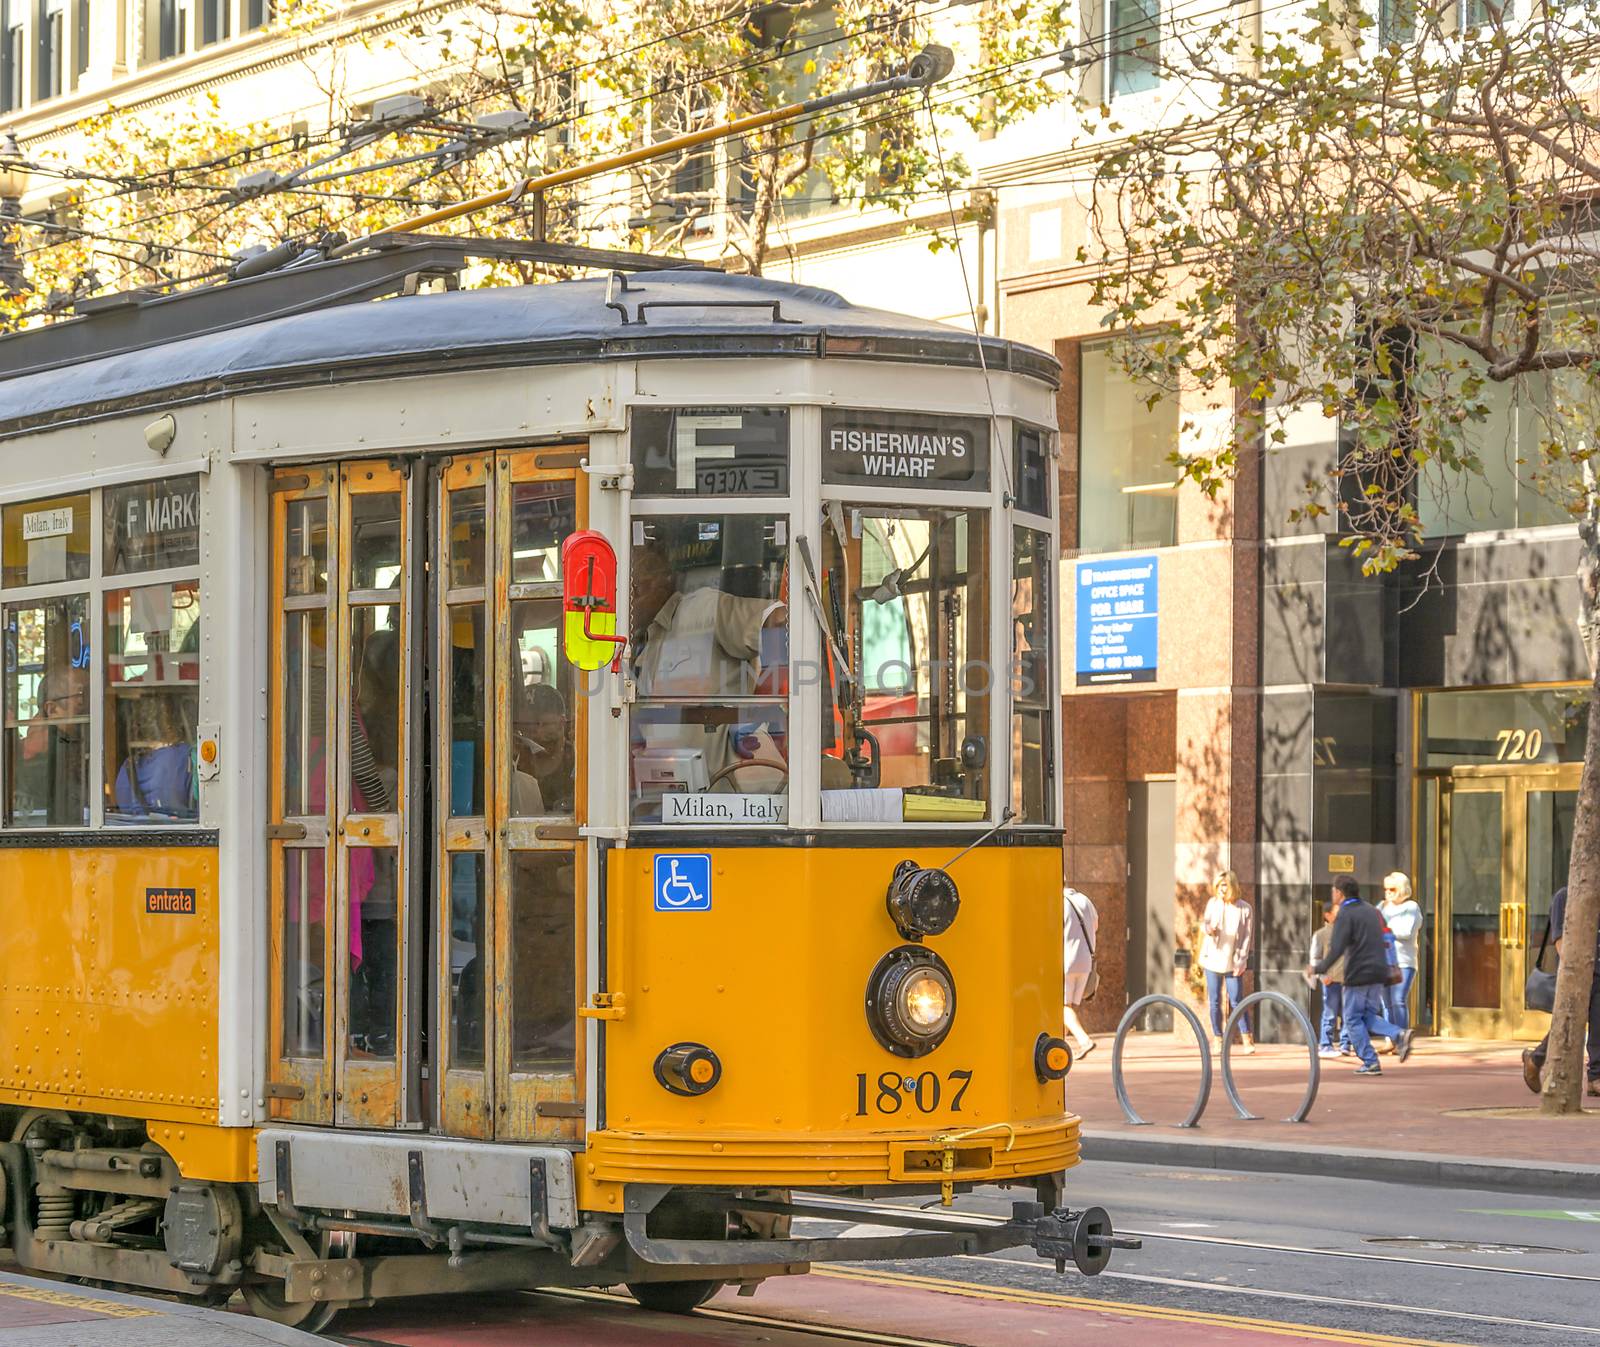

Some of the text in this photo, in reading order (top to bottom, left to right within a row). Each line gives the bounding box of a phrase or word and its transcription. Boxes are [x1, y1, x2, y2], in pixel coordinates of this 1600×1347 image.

[676, 415, 742, 489] F
[829, 430, 966, 458] FISHERMAN'S
[862, 455, 936, 478] WHARF
[26, 511, 70, 535] Milan, Italy
[126, 498, 139, 538] F
[1119, 584, 1144, 596] SPACE
[1495, 728, 1543, 762] 720
[672, 796, 784, 822] Milan, Italy
[149, 890, 192, 912] entrata
[855, 1069, 973, 1116] 1807
